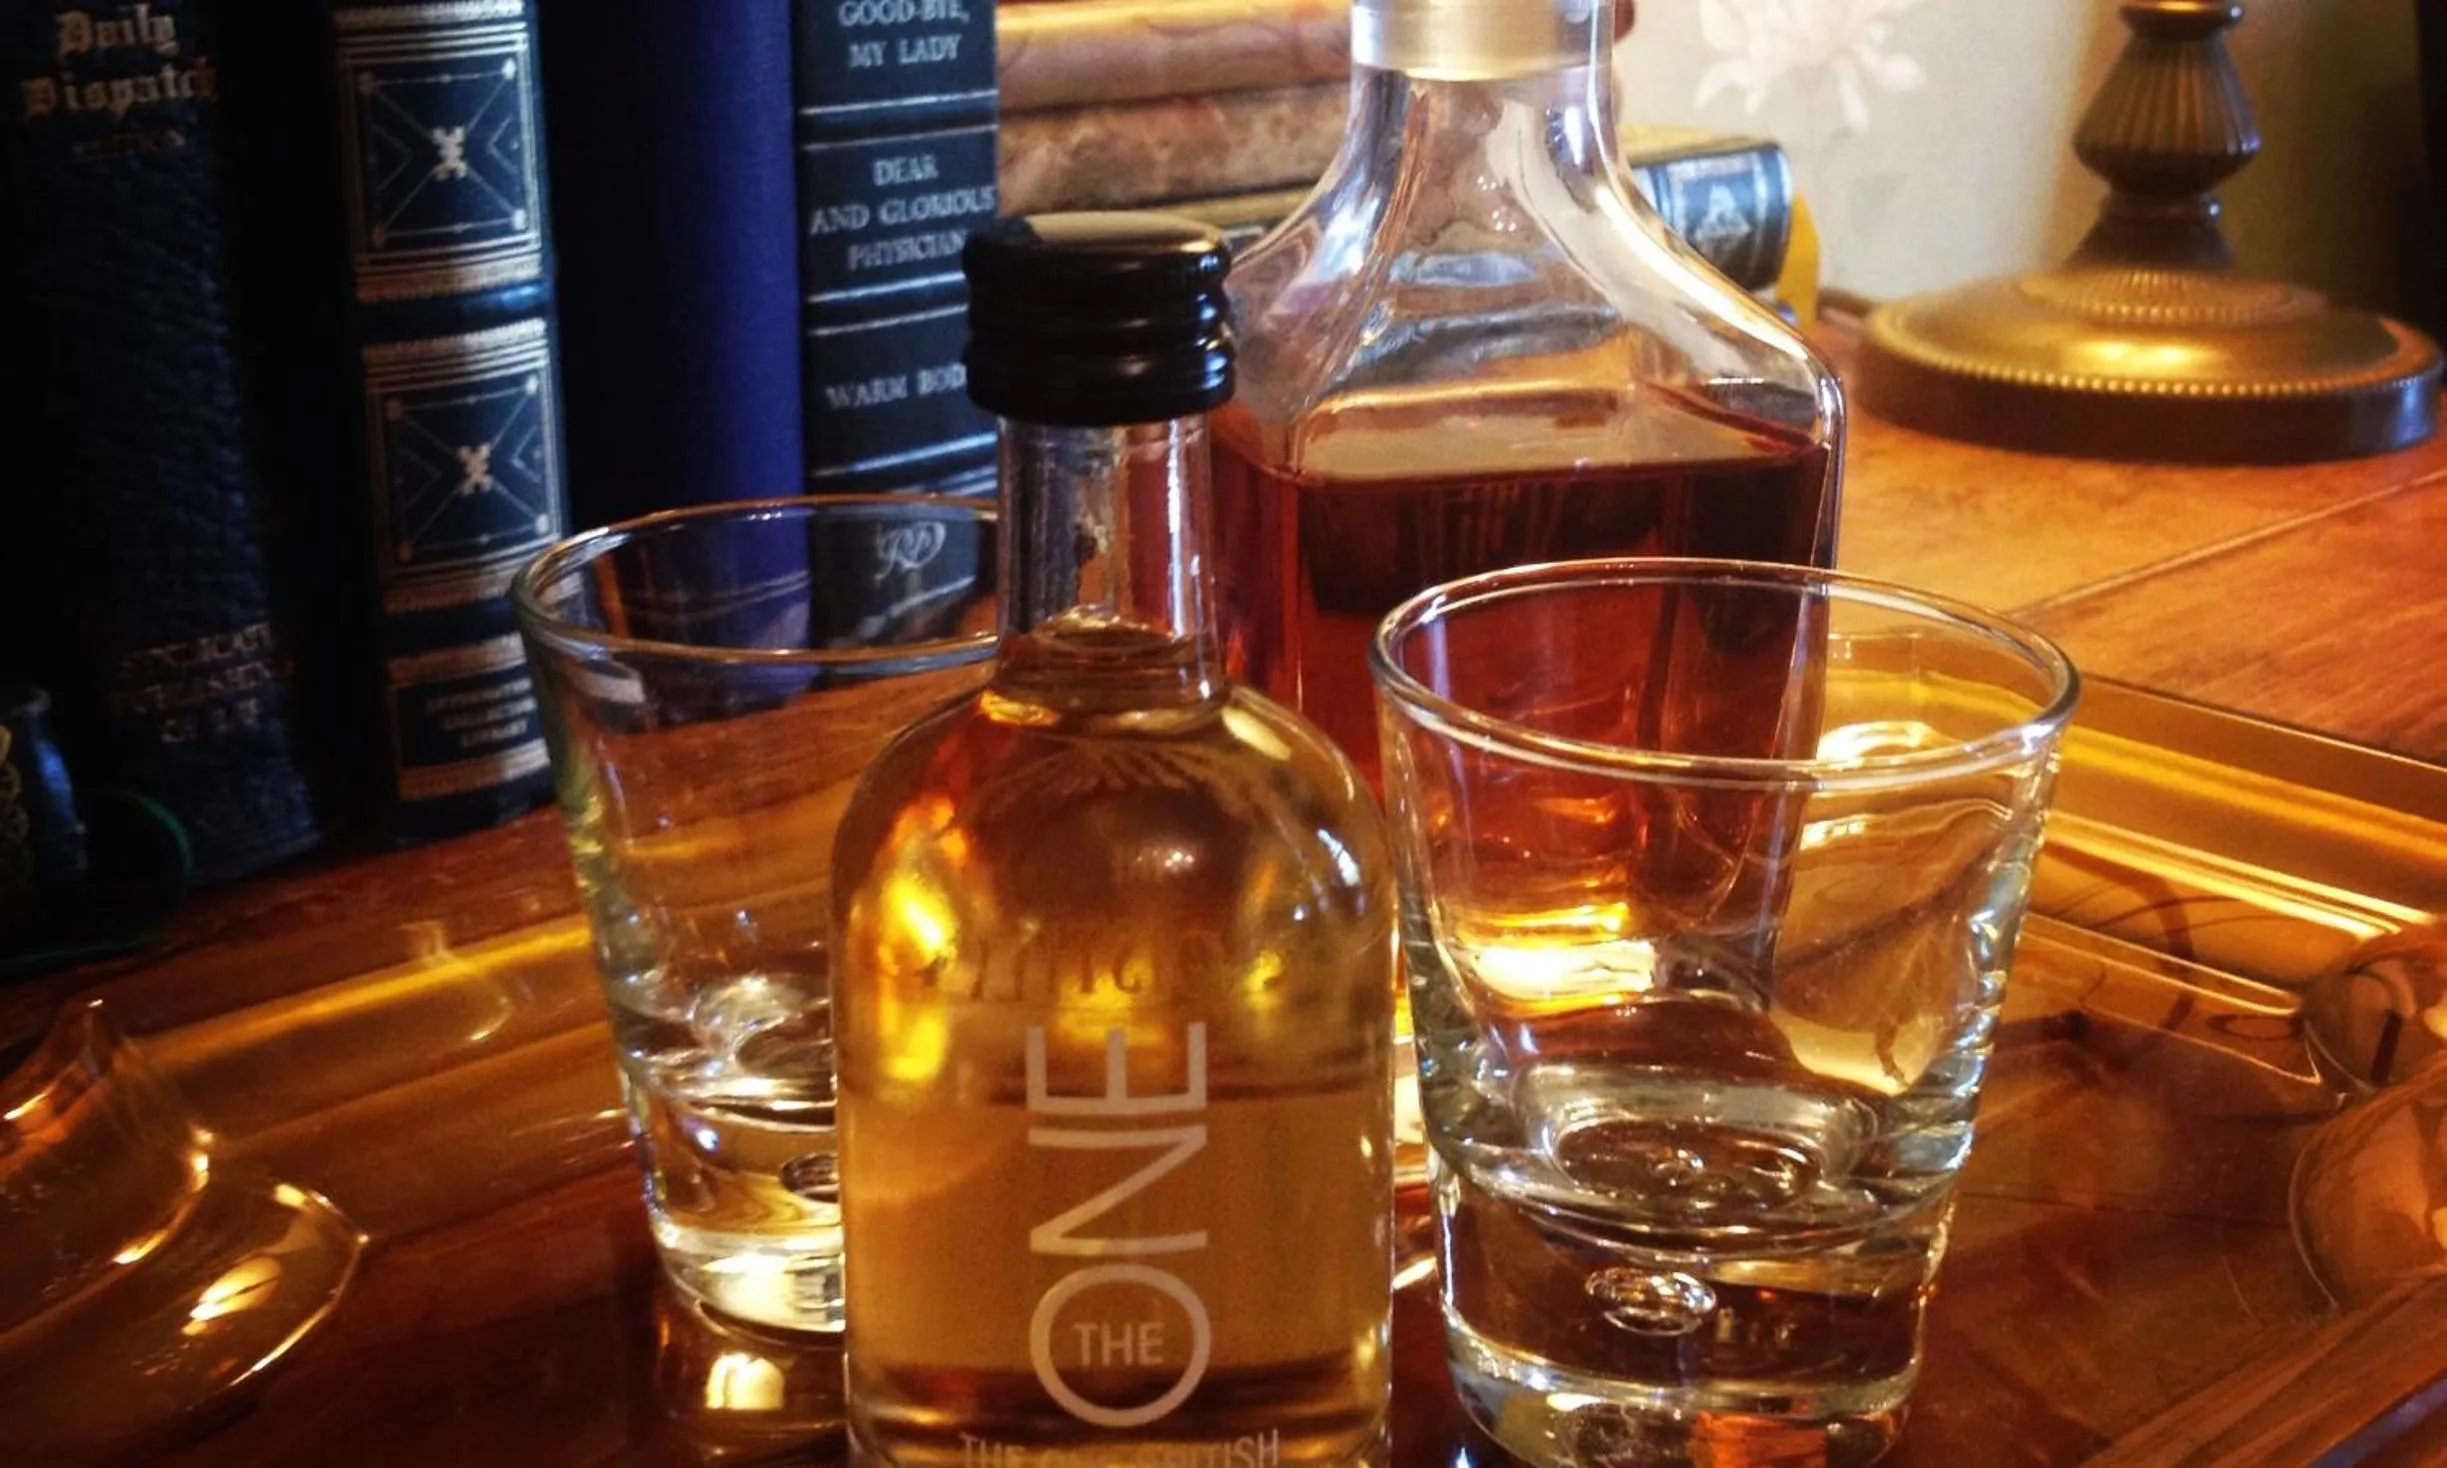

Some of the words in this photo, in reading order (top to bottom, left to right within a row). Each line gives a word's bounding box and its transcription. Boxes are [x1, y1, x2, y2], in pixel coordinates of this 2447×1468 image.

[55, 3, 180, 58] Daily
[849, 40, 887, 68] MY
[897, 34, 962, 65] LADY
[22, 57, 218, 120] Dispatch
[873, 155, 939, 186] DEAR
[810, 203, 870, 235] AND
[878, 186, 996, 225] GLORIOUS
[847, 230, 969, 271] PHYSICIAN
[825, 374, 908, 411] WARM
[917, 362, 968, 396] BOD
[1025, 1021, 1211, 1430] ONE
[1072, 1321, 1164, 1366] THE
